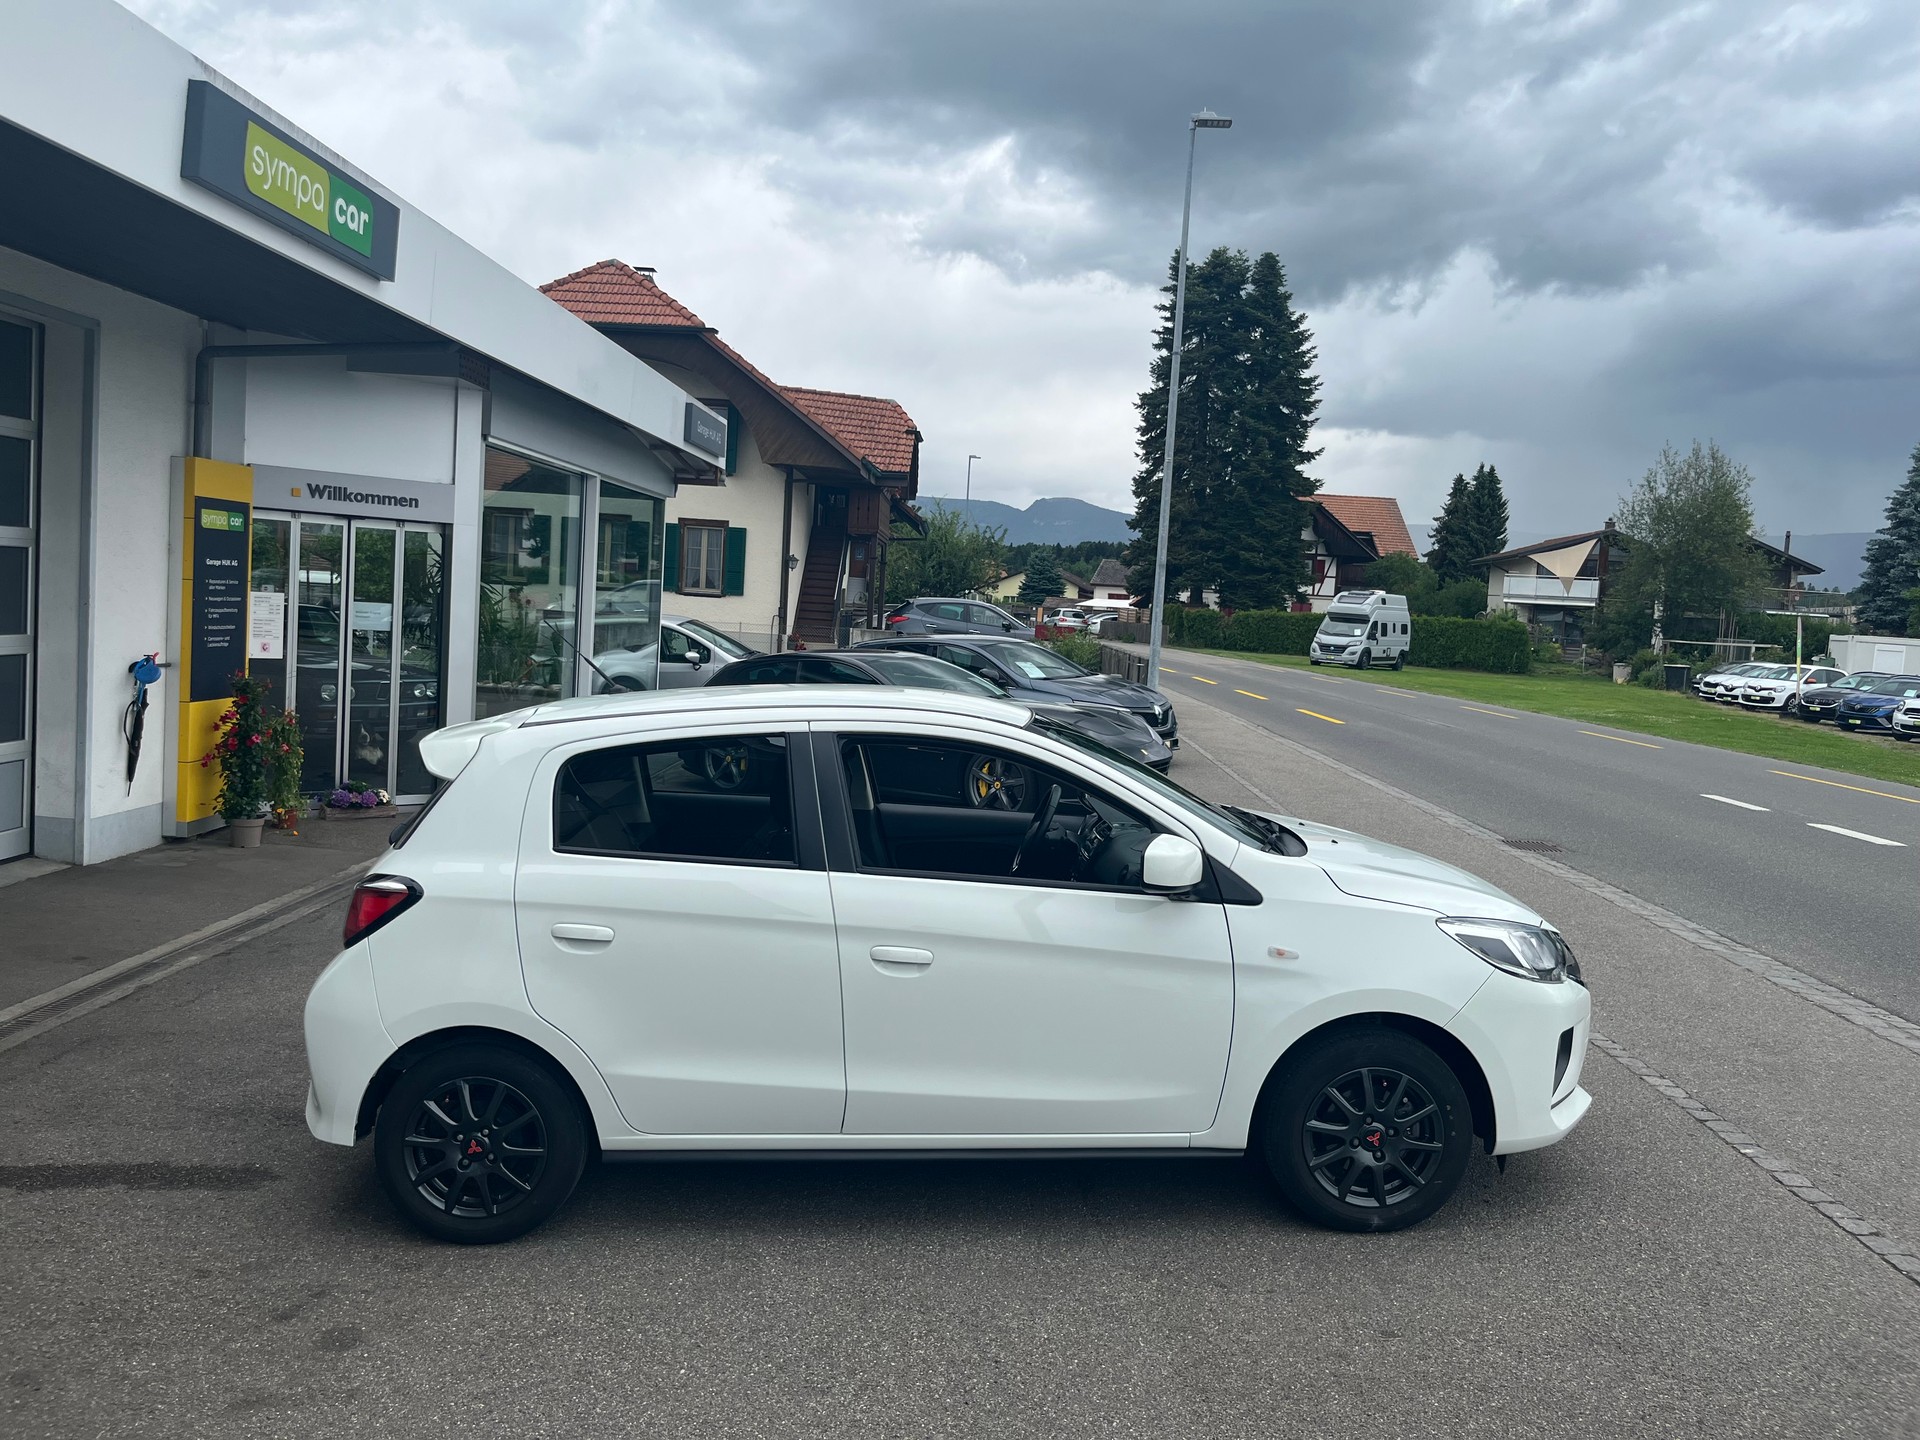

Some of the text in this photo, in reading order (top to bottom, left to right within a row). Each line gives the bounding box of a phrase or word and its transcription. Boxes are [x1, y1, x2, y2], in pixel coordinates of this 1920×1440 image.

[252, 145, 369, 235] sympa car
[306, 482, 420, 509] Willkommen
[203, 514, 243, 527] sympa car
[206, 558, 221, 567] Garage
